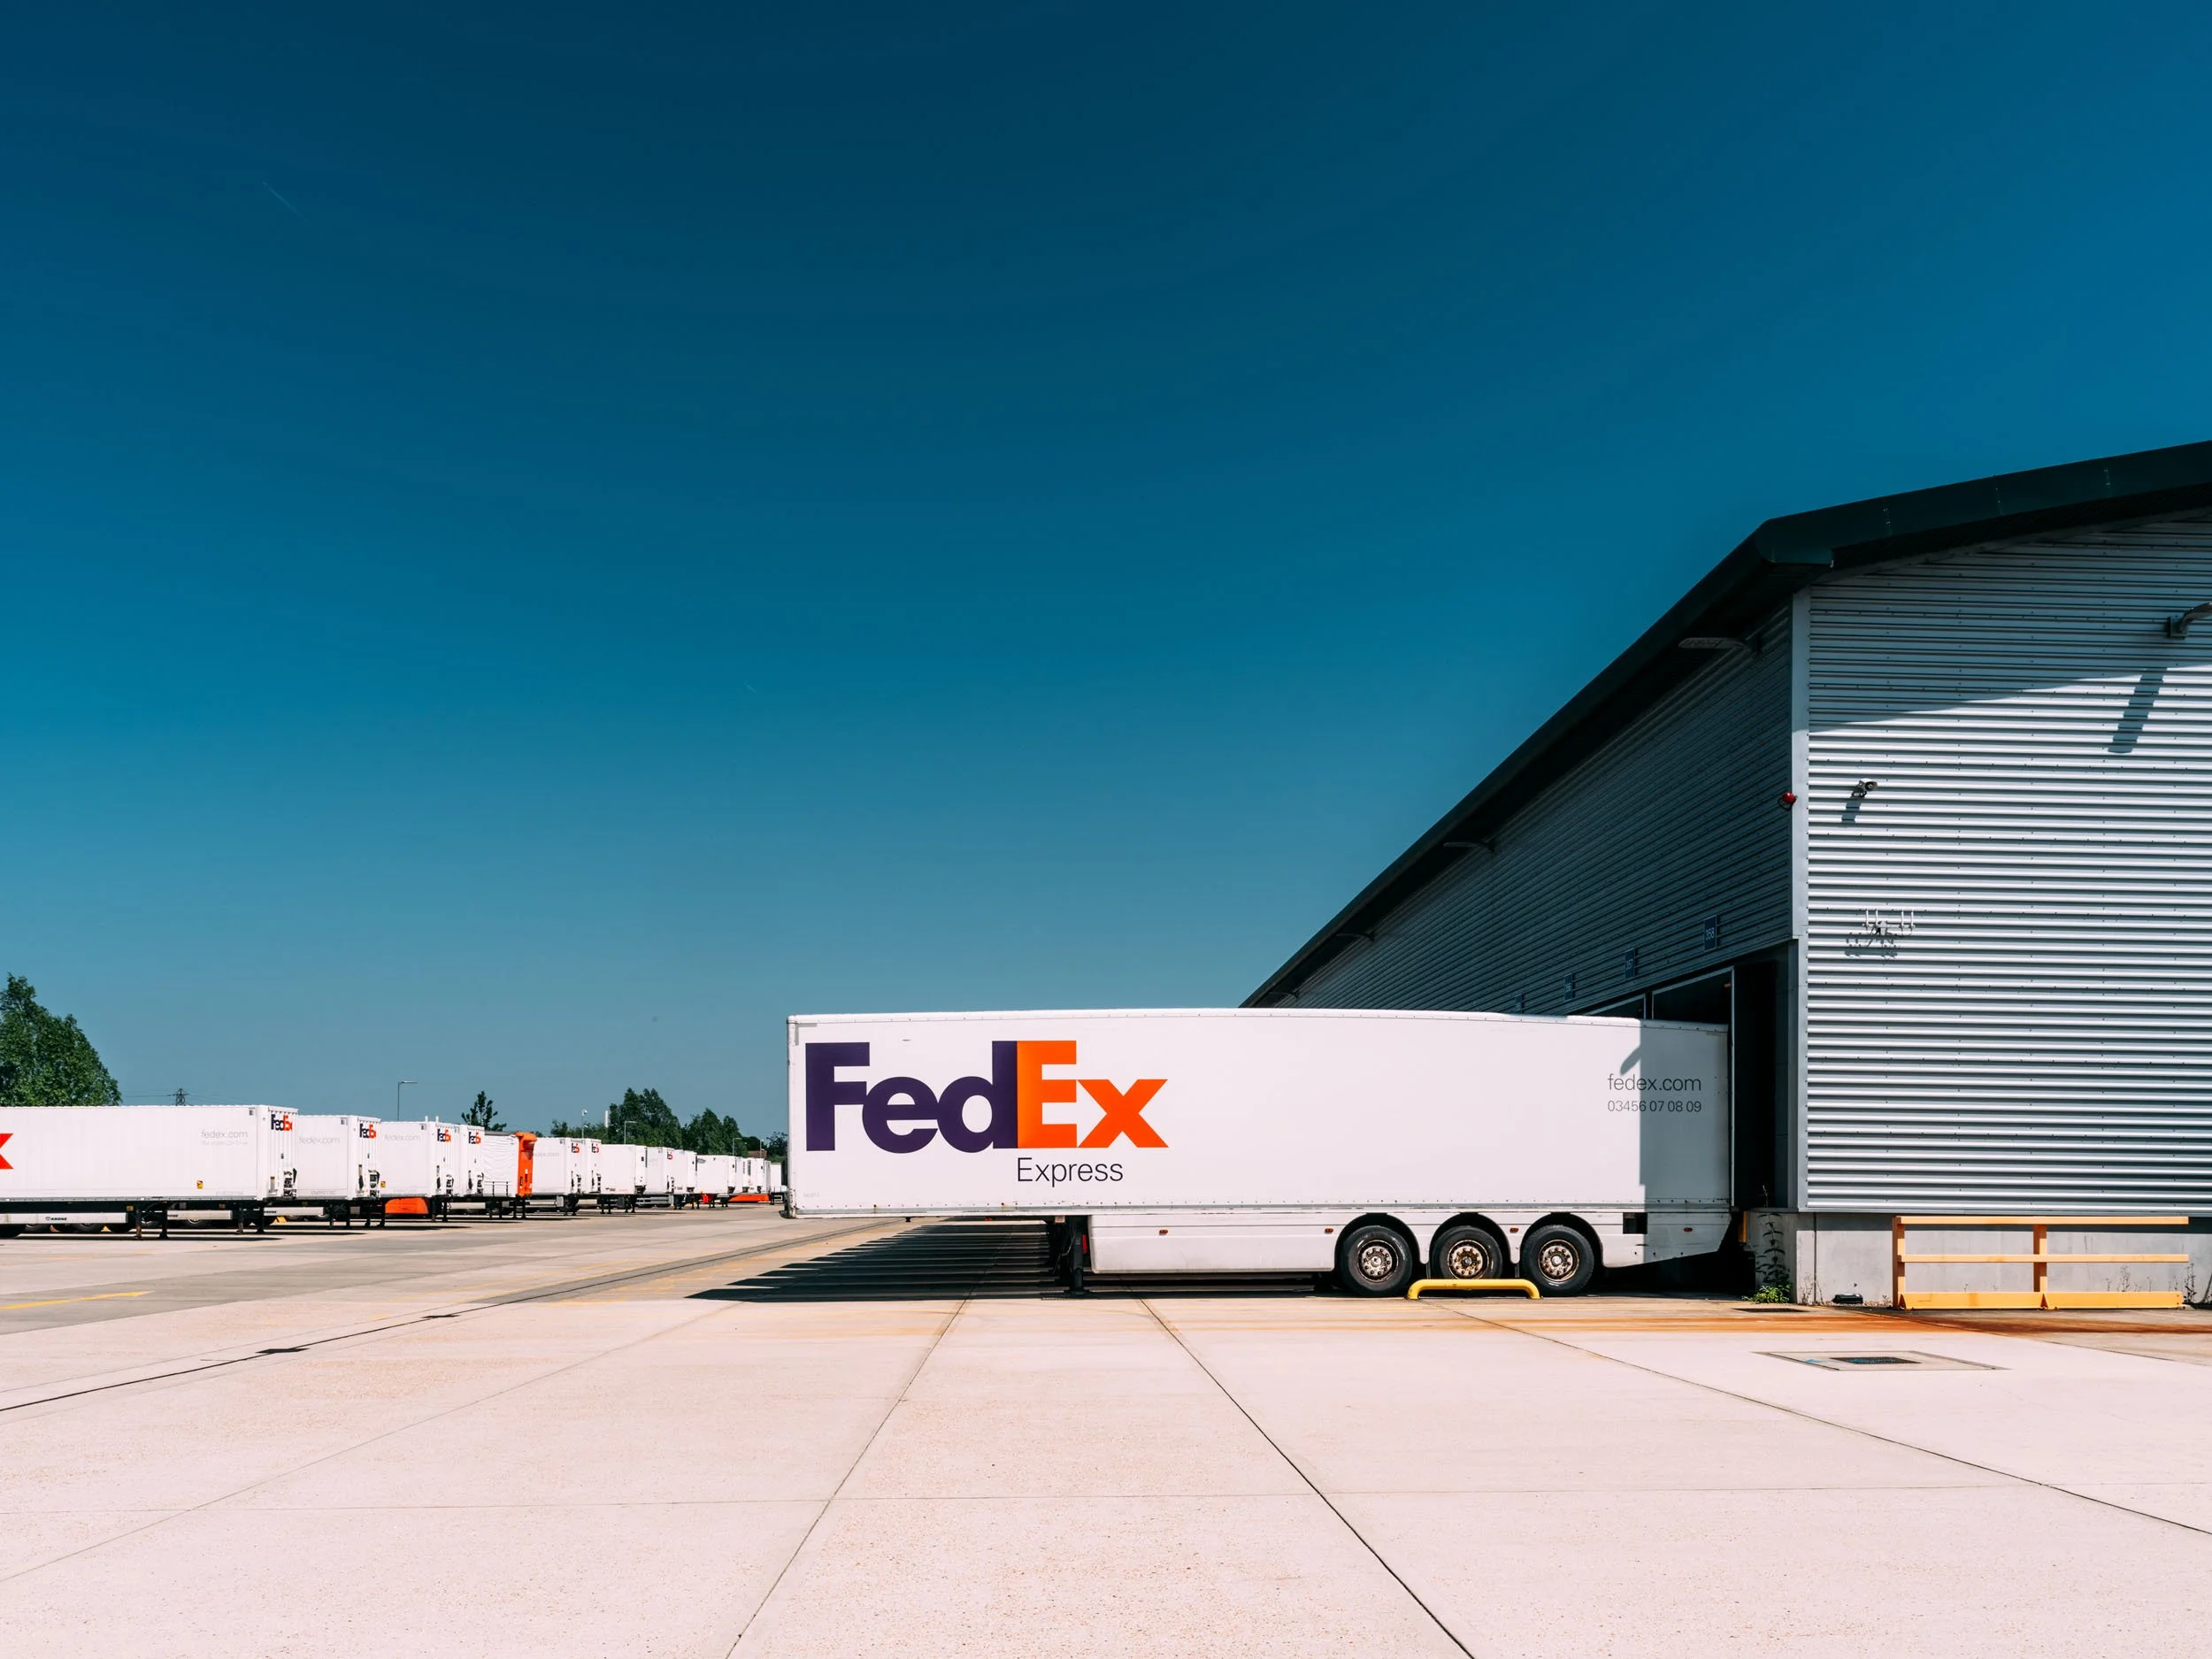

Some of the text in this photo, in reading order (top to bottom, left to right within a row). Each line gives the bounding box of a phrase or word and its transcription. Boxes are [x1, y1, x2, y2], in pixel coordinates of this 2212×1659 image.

[1607, 1072, 1701, 1092] fedex.com
[805, 1039, 1169, 1154] FedEx
[1607, 1100, 1702, 1113] 03456 07 08 09
[201, 1129, 249, 1139] fedex.com
[1017, 1156, 1124, 1187] Express
